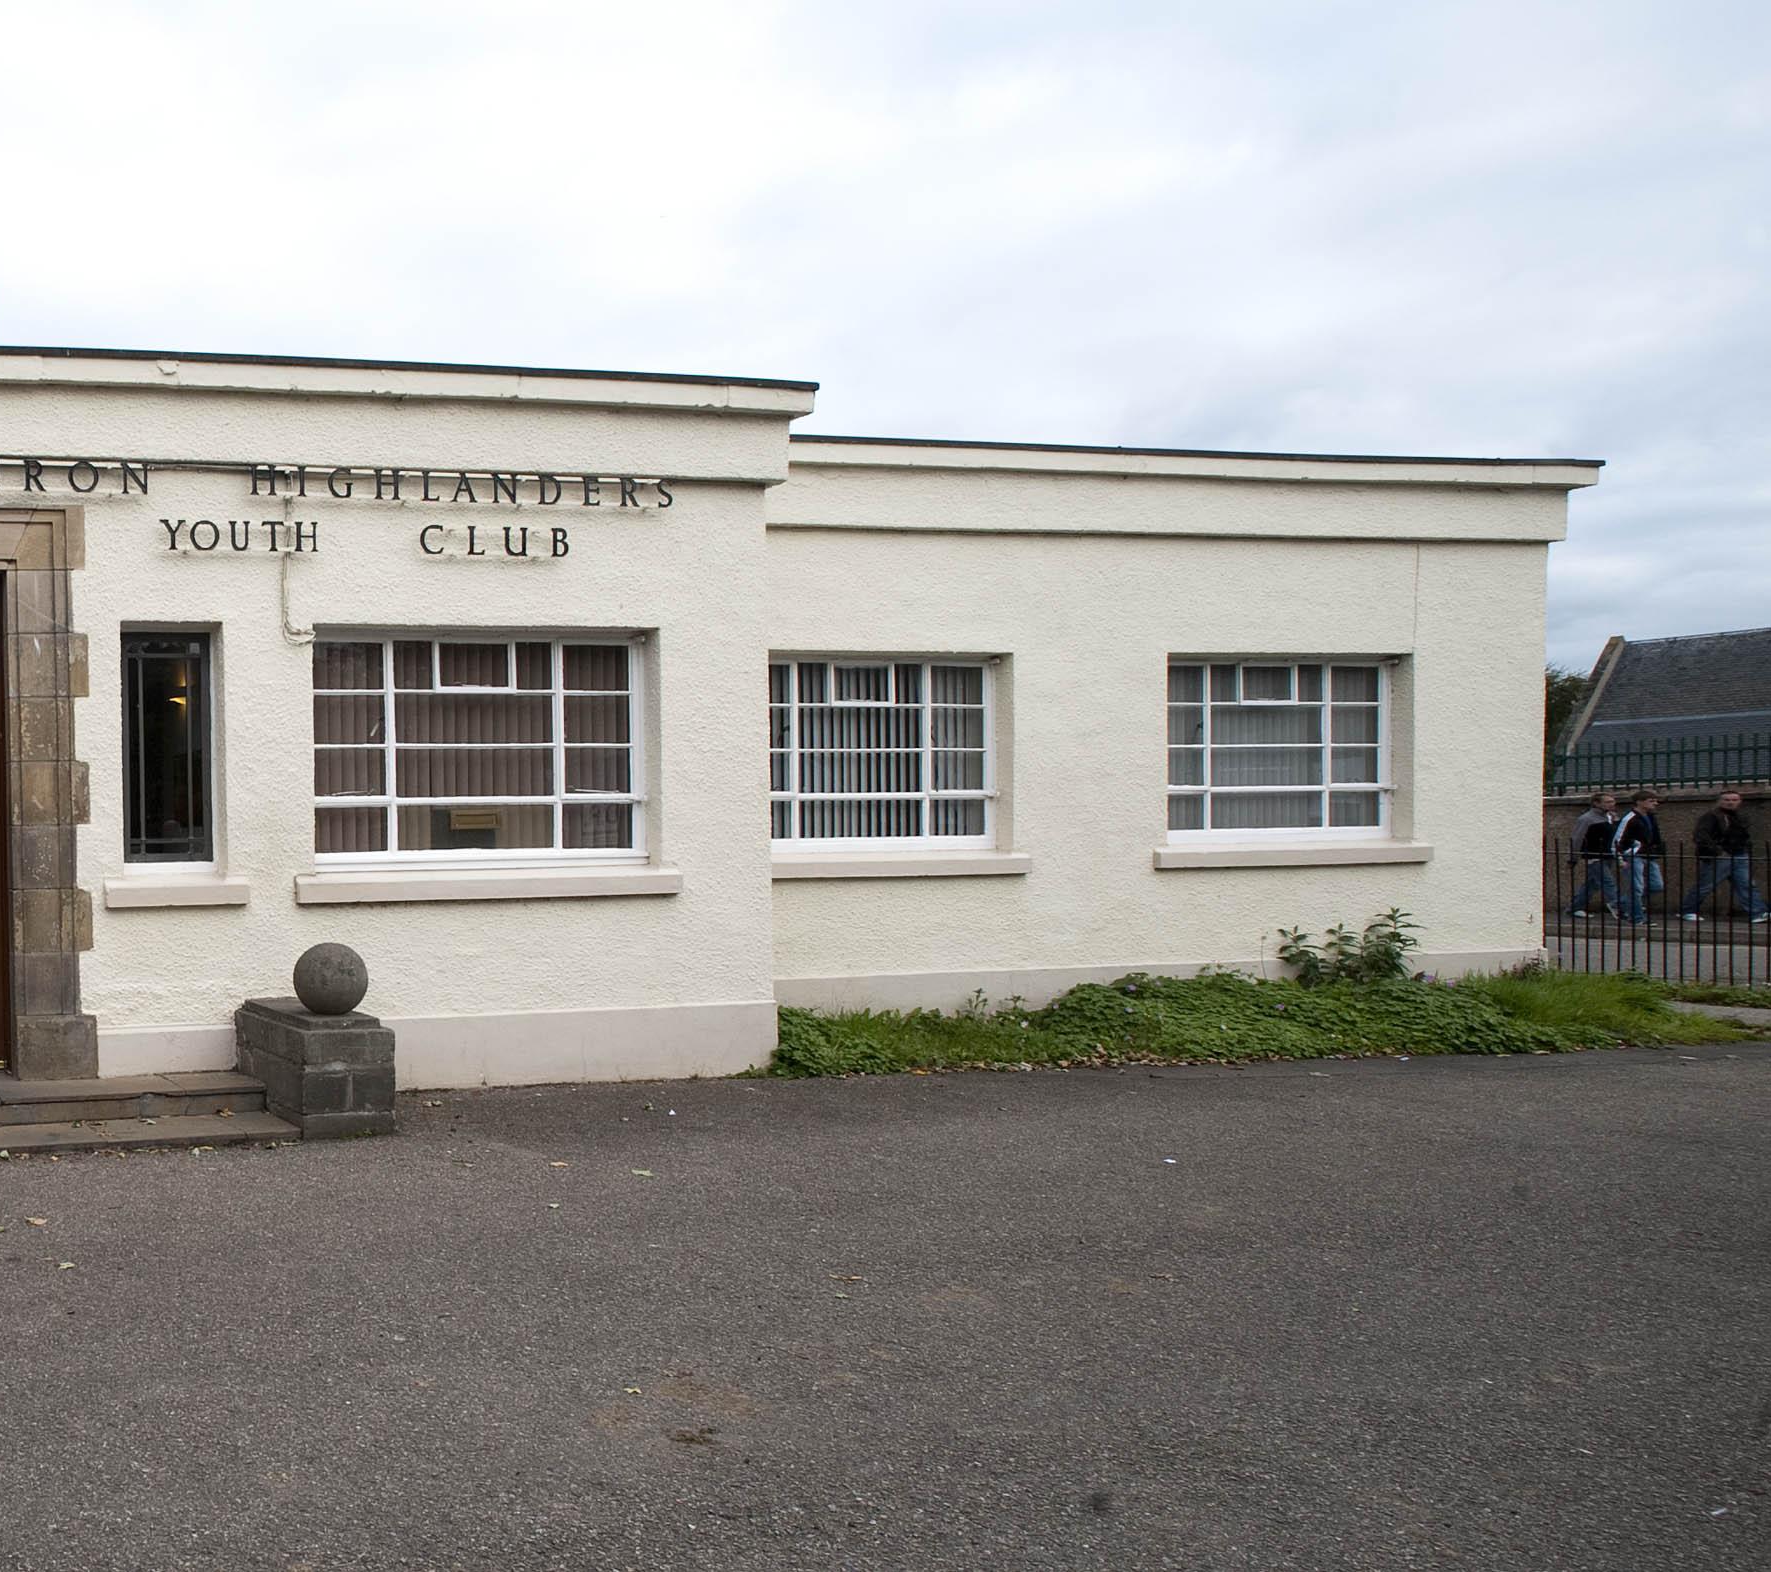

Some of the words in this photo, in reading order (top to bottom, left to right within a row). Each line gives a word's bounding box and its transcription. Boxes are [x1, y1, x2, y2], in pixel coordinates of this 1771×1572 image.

[250, 464, 674, 508] HIGHLANDERS
[159, 518, 319, 552] YOUTH
[420, 525, 570, 558] CLUB
